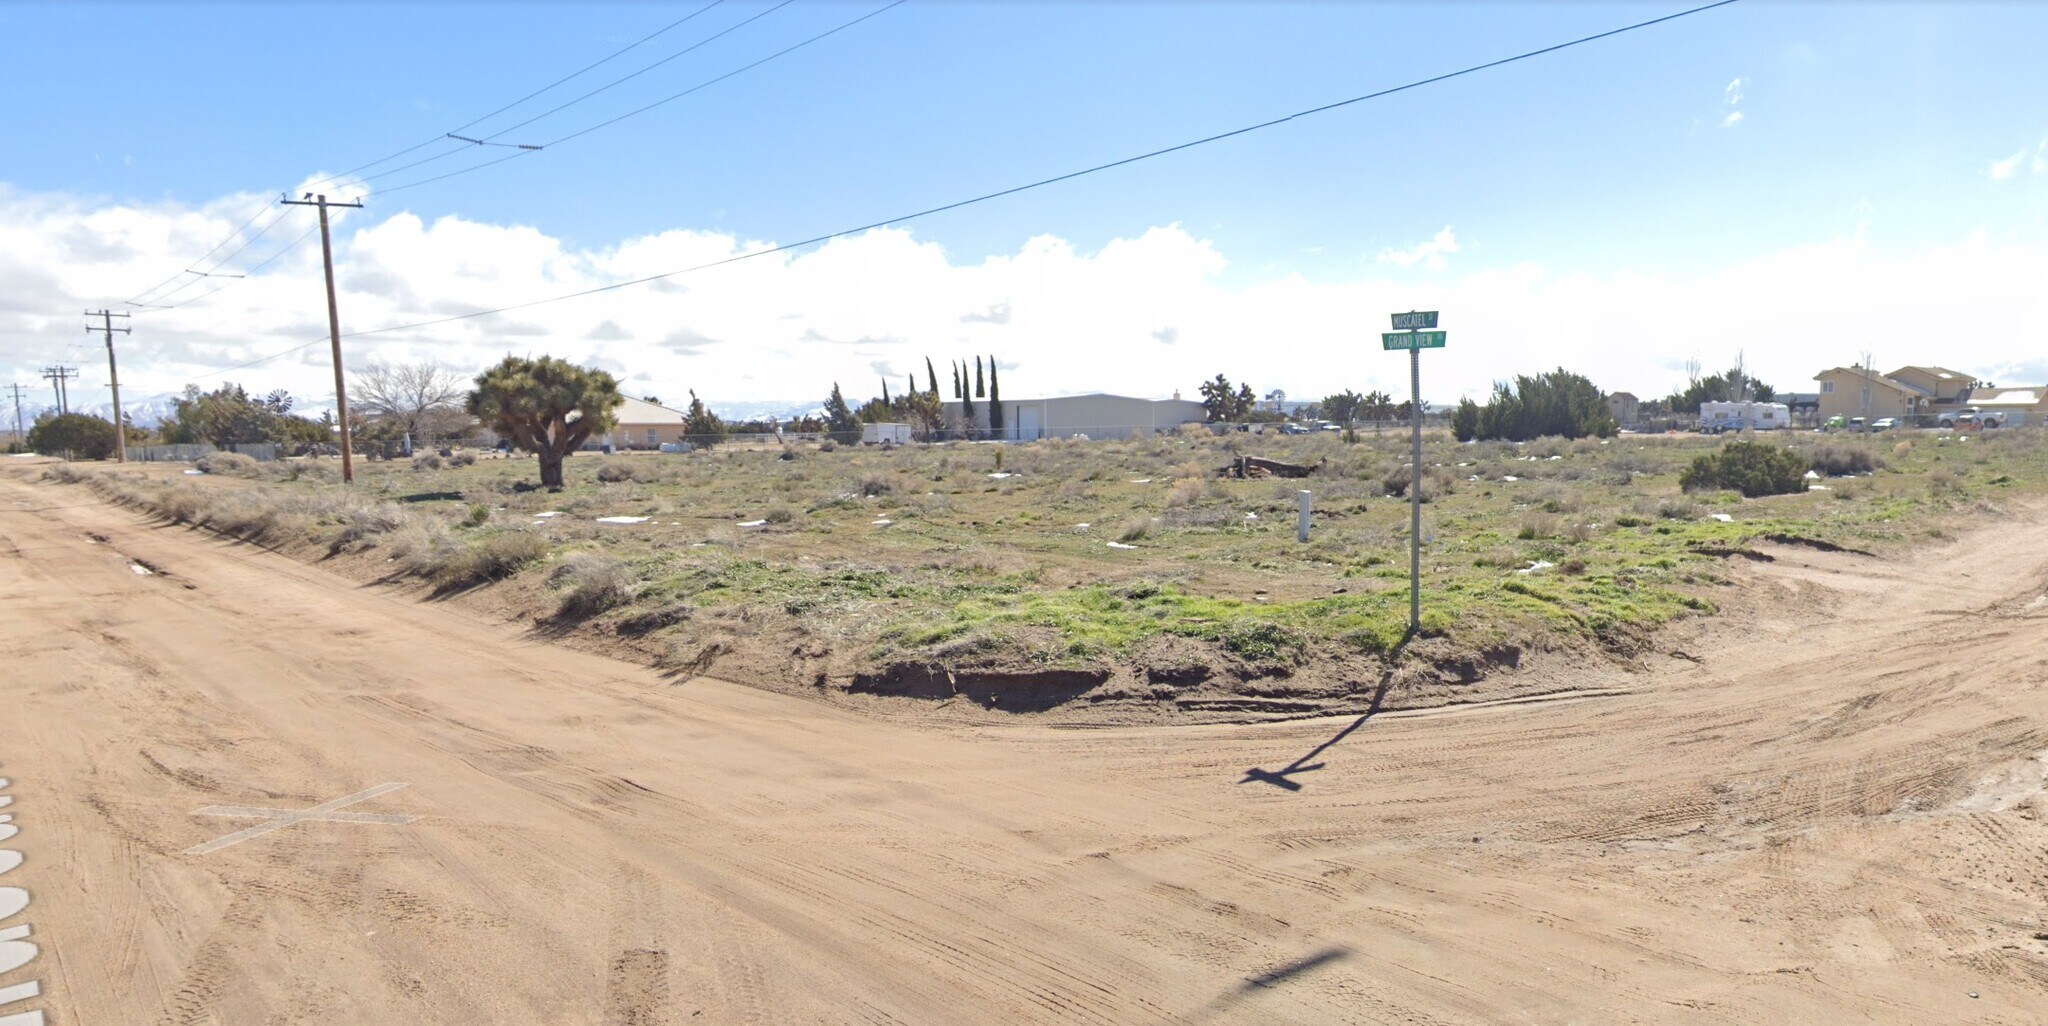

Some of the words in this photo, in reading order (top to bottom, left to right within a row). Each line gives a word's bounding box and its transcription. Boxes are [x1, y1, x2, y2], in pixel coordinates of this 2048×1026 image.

[1393, 313, 1426, 328] MUSCATEL
[1389, 335, 1412, 349] GRAND
[1415, 334, 1433, 347] VIEW
